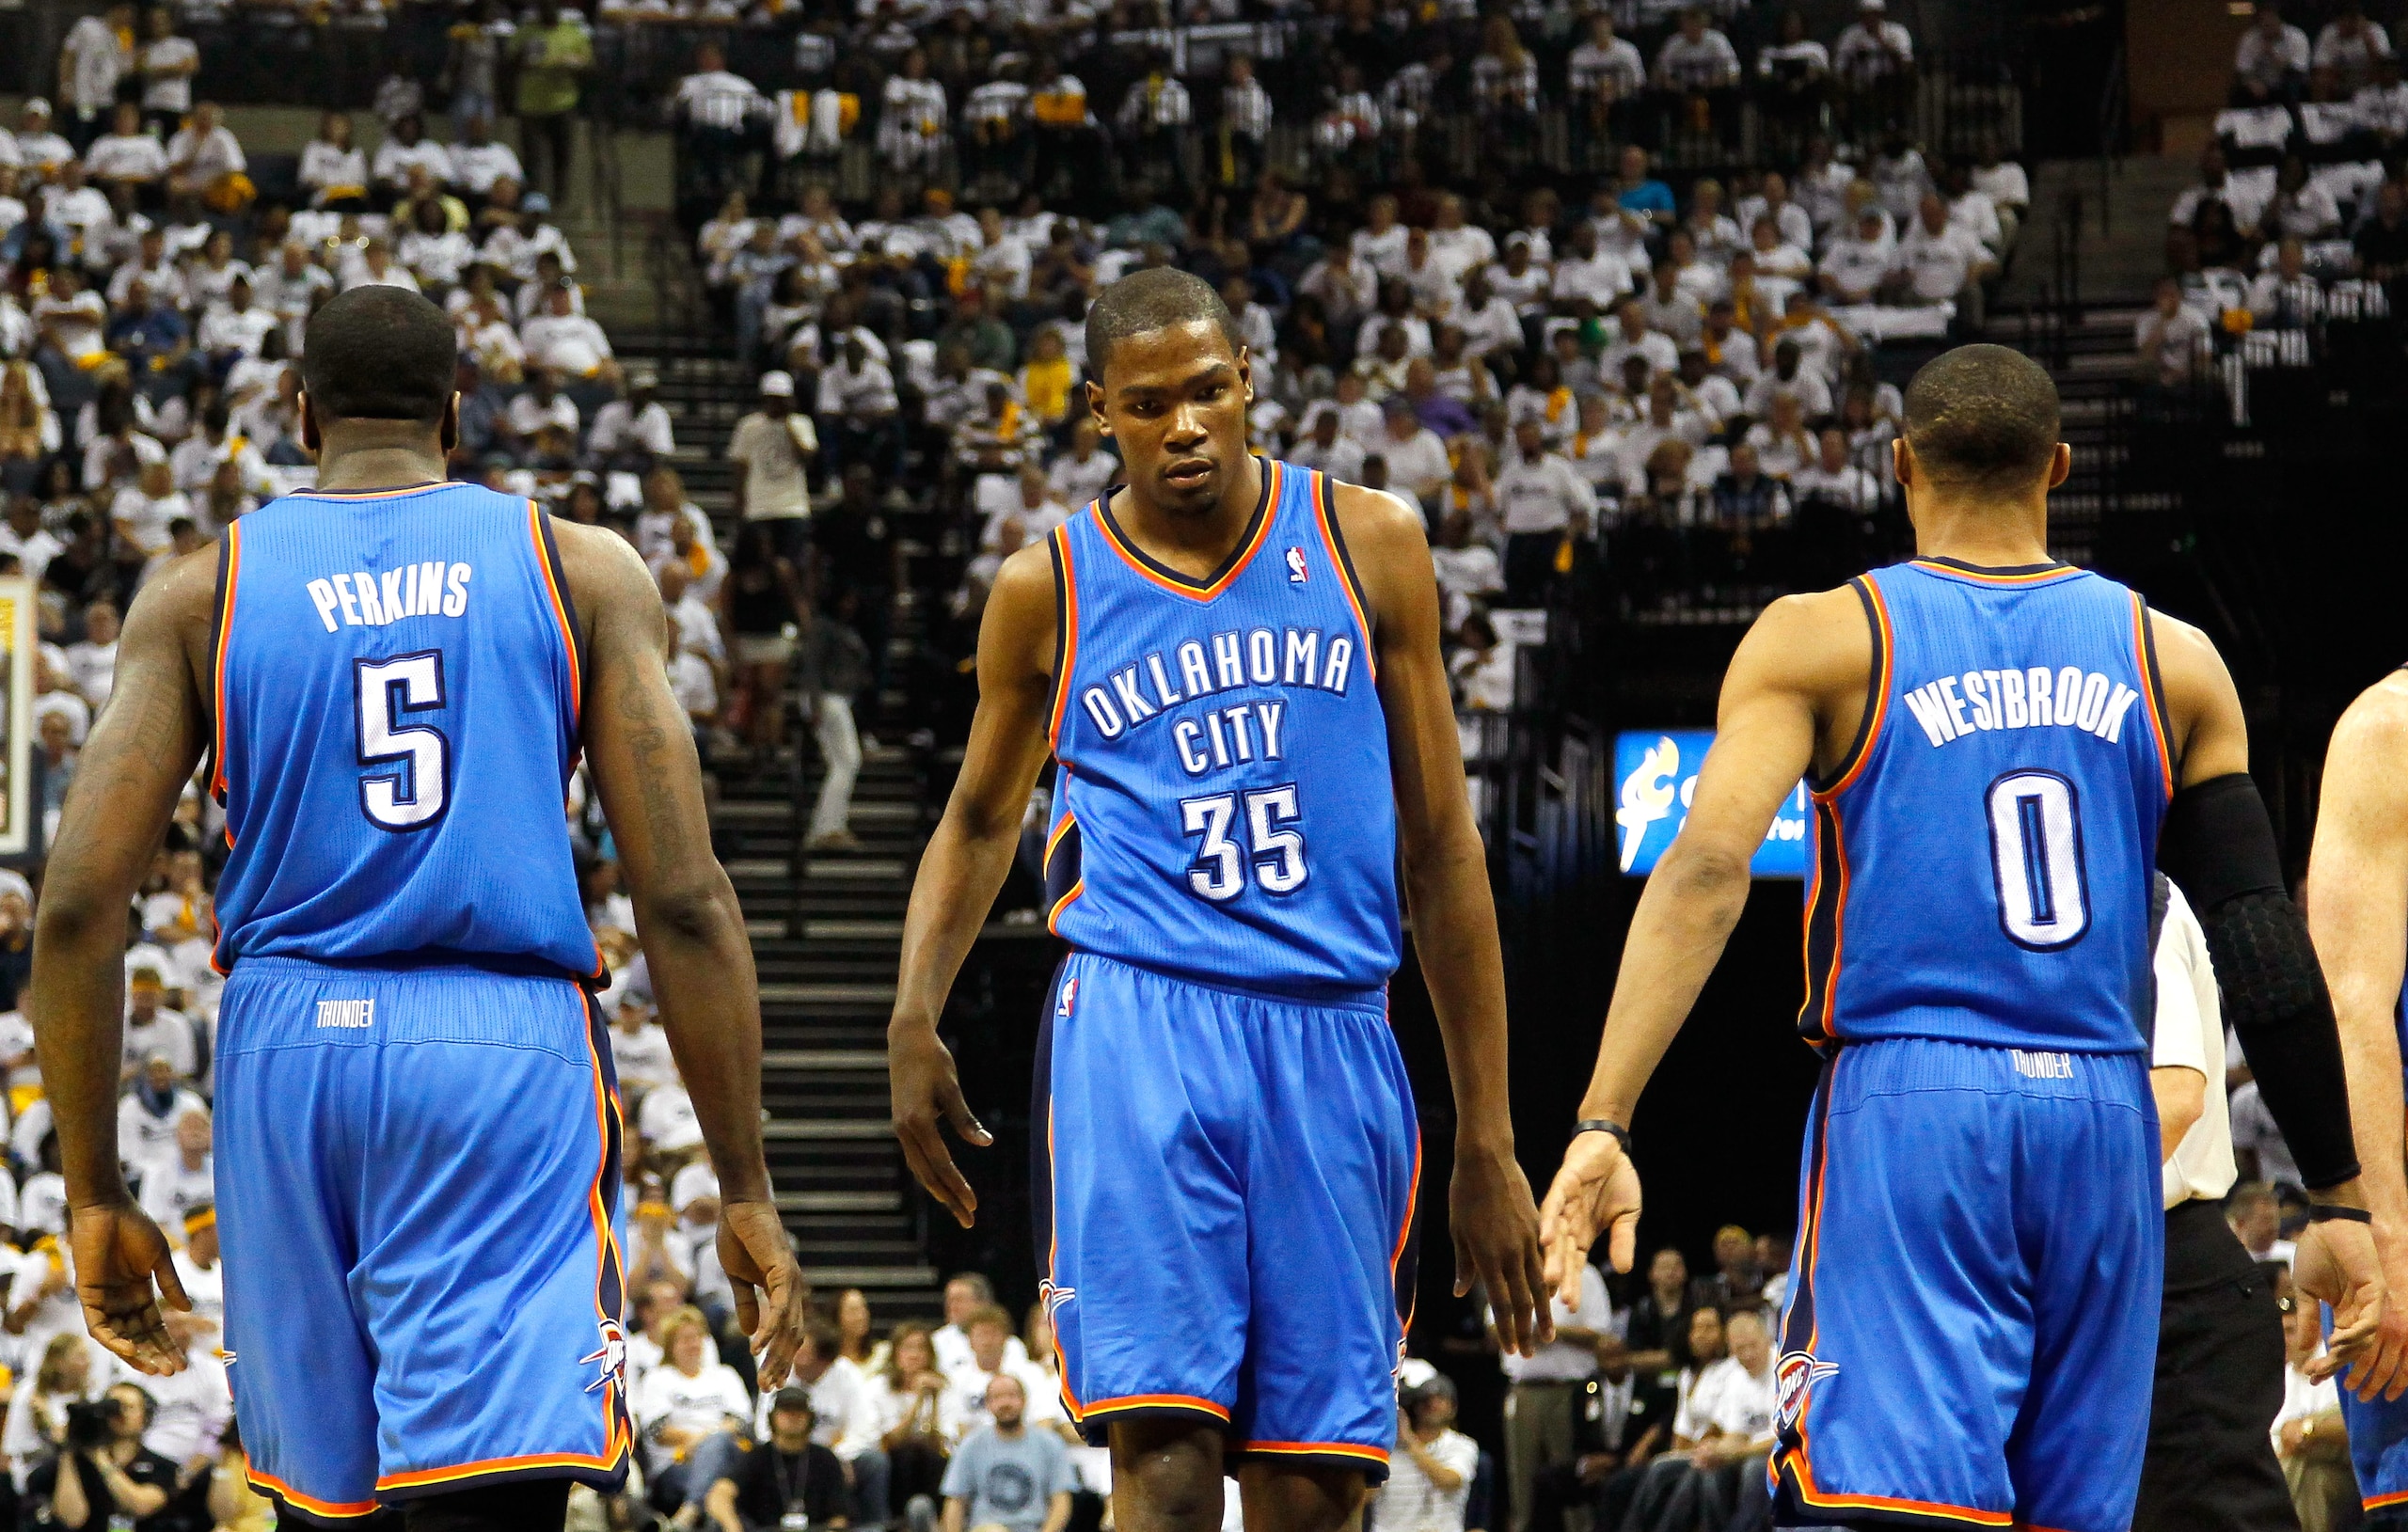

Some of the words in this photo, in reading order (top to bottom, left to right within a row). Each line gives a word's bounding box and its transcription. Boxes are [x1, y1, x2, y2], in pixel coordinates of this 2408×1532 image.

[306, 561, 471, 633] PERKINS
[1083, 627, 1356, 740] OKLAHOMA
[1903, 666, 2139, 748] WESTBROOK
[353, 649, 451, 833] 5
[1173, 699, 1287, 776] CITY
[1180, 782, 1309, 903] 35
[1984, 767, 2093, 953] 0
[2009, 1049, 2073, 1079] THUNDER
